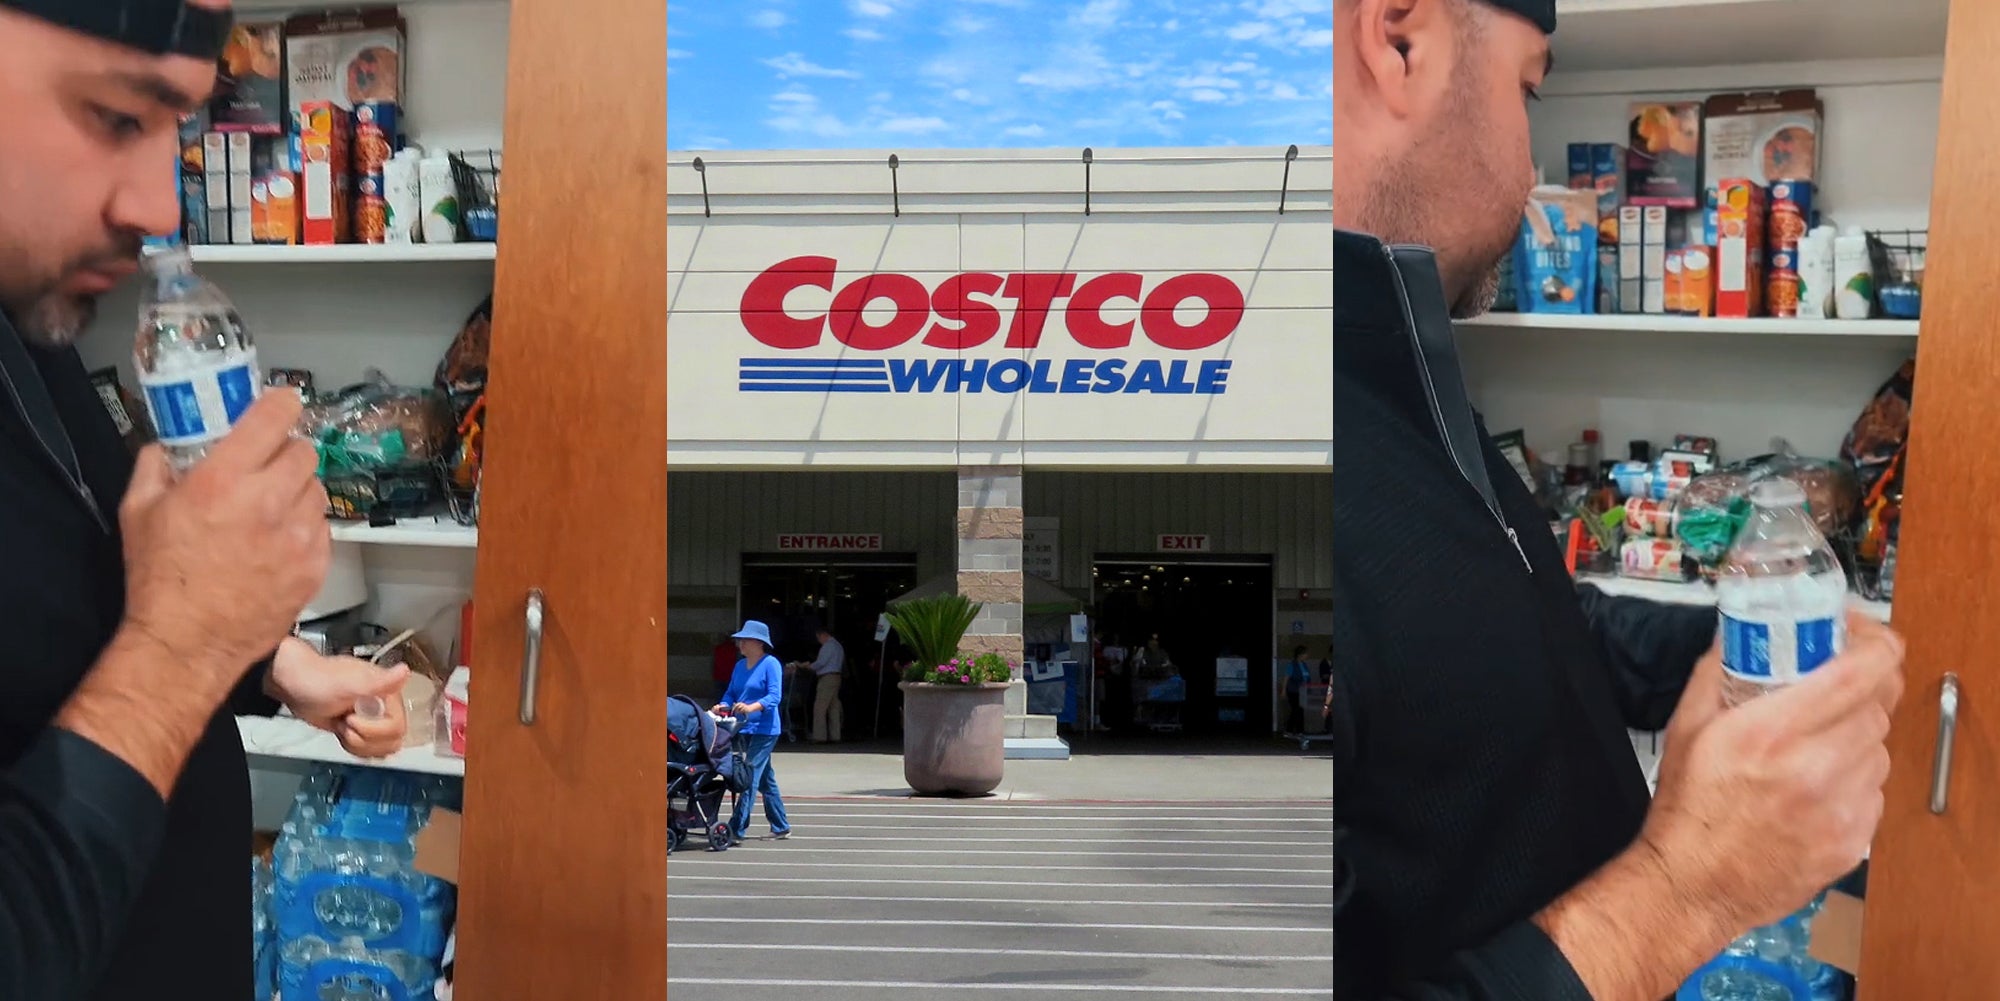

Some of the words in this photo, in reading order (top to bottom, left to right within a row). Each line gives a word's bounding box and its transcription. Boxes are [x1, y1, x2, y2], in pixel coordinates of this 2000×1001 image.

[740, 255, 1245, 350] COSTCO
[887, 359, 1232, 394] WHOLESALE
[780, 535, 880, 549] ENTRANCE
[1162, 536, 1205, 549] EXIT
